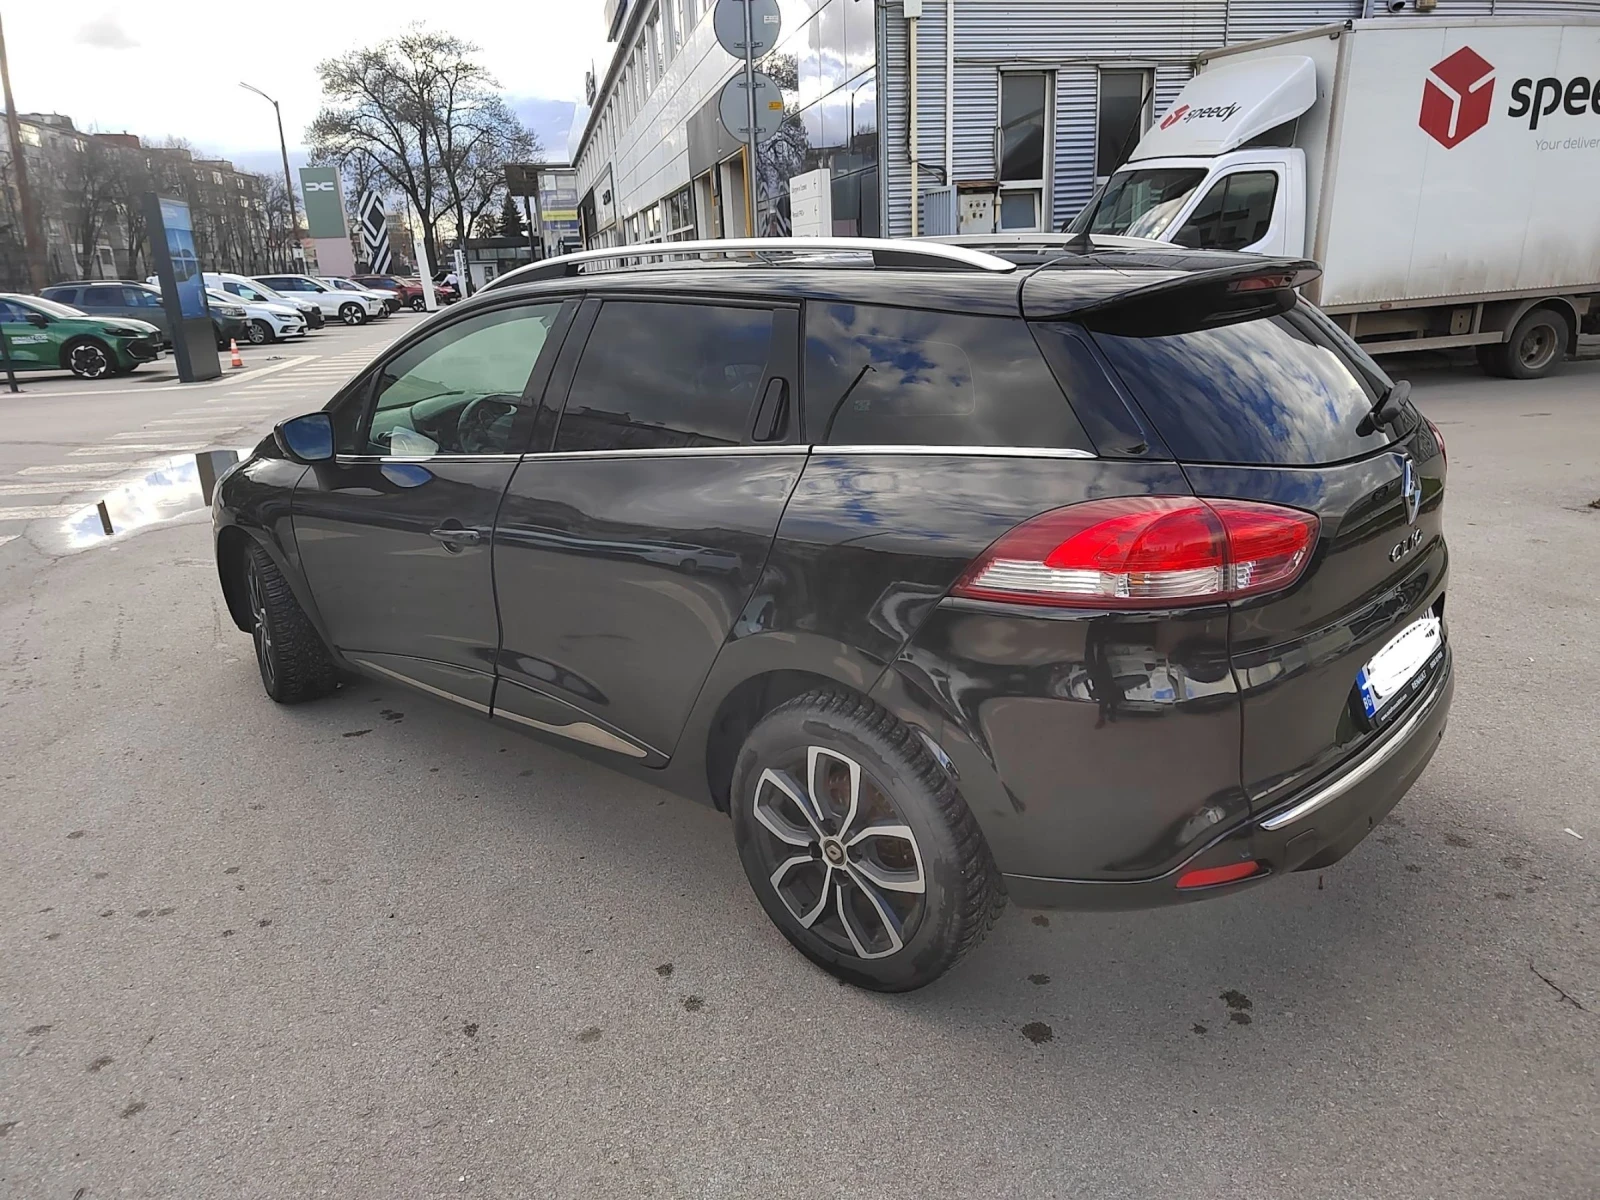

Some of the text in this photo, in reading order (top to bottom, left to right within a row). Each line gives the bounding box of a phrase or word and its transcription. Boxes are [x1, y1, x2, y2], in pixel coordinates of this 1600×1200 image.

[1183, 101, 1242, 123] speedy
[1535, 138, 1561, 151] Your
[1363, 694, 1372, 710] BG
